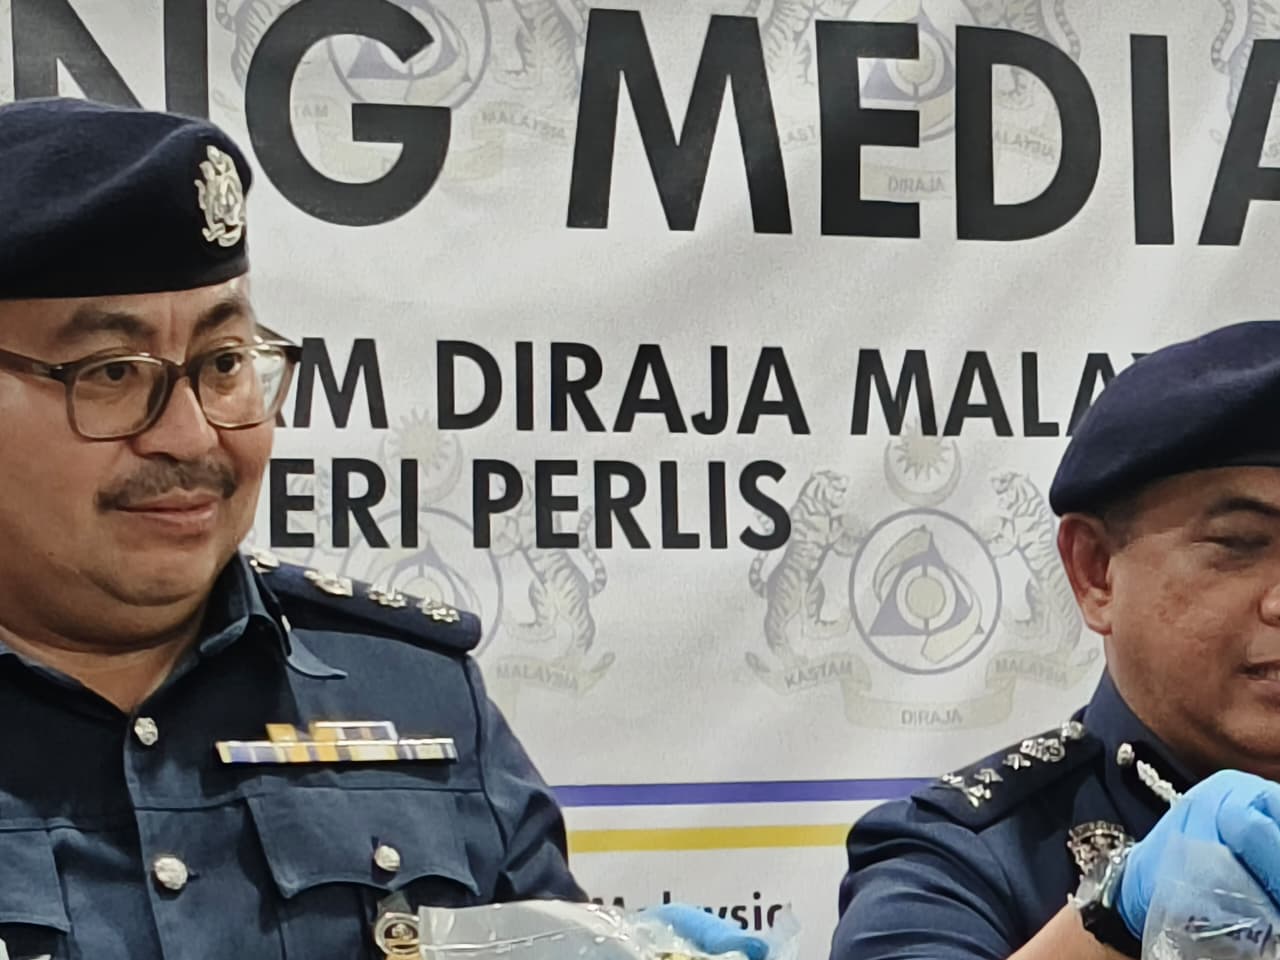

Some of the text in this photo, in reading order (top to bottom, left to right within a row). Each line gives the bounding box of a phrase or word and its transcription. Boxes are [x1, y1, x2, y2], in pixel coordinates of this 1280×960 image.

[436, 340, 810, 436] DIRAJA
[850, 348, 1153, 438] MALA
[473, 459, 793, 550] PERLIS
[902, 708, 964, 727] DIRAJA
